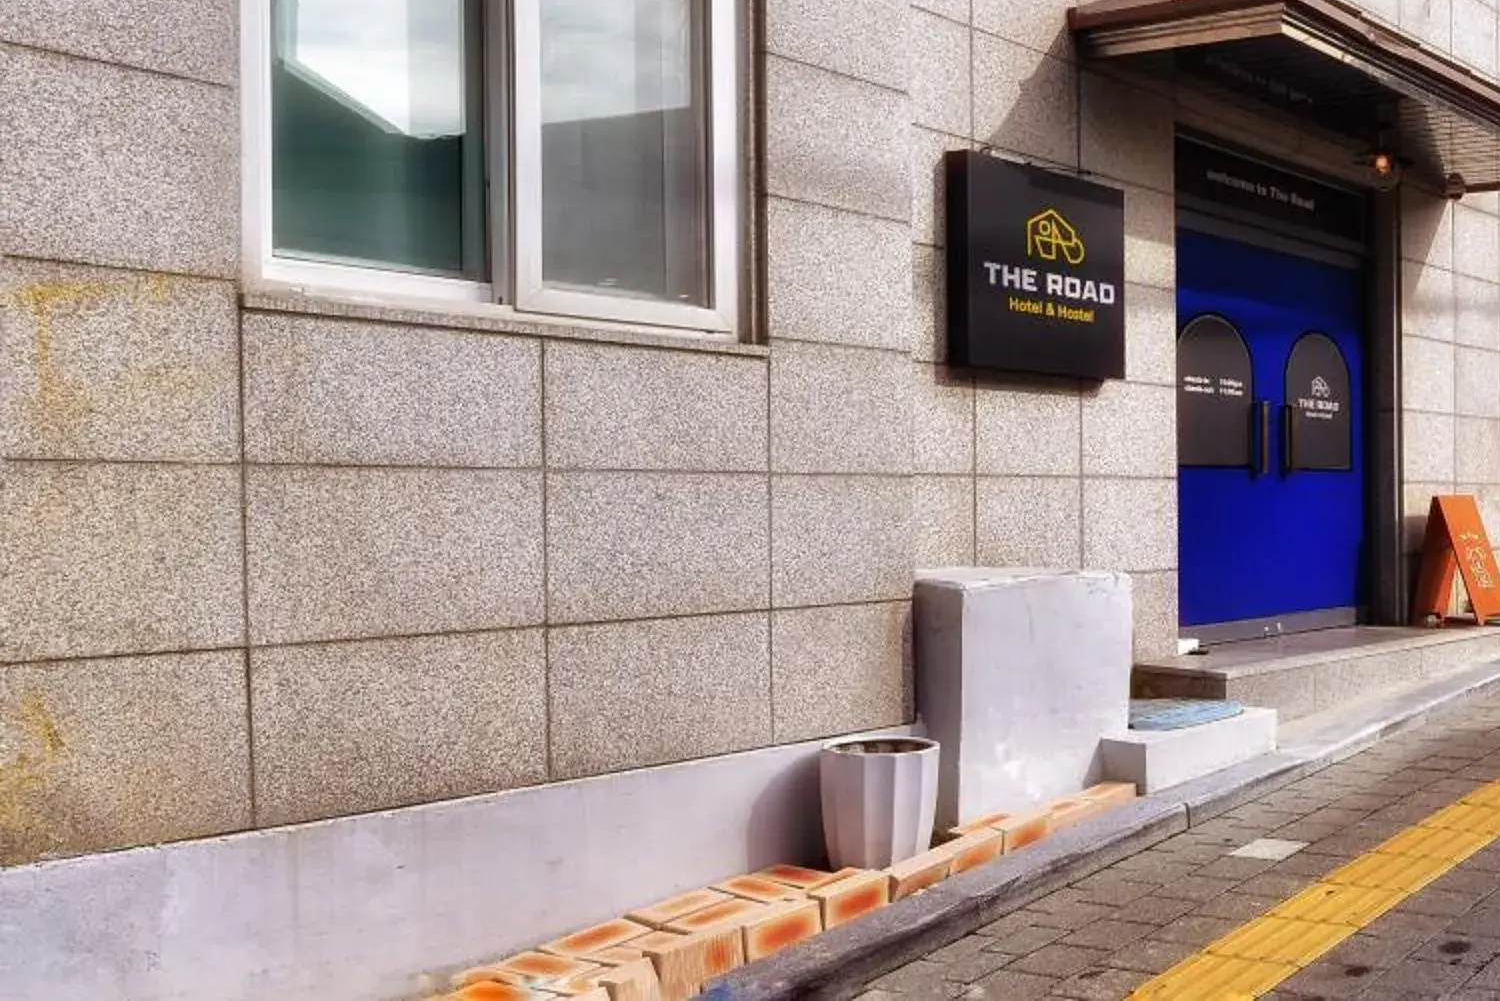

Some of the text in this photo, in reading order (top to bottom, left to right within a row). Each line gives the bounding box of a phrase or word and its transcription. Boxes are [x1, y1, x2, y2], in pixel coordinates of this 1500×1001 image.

[984, 261, 1115, 304] THE ROAD
[1009, 296, 1095, 323] Hotel & Hostel
